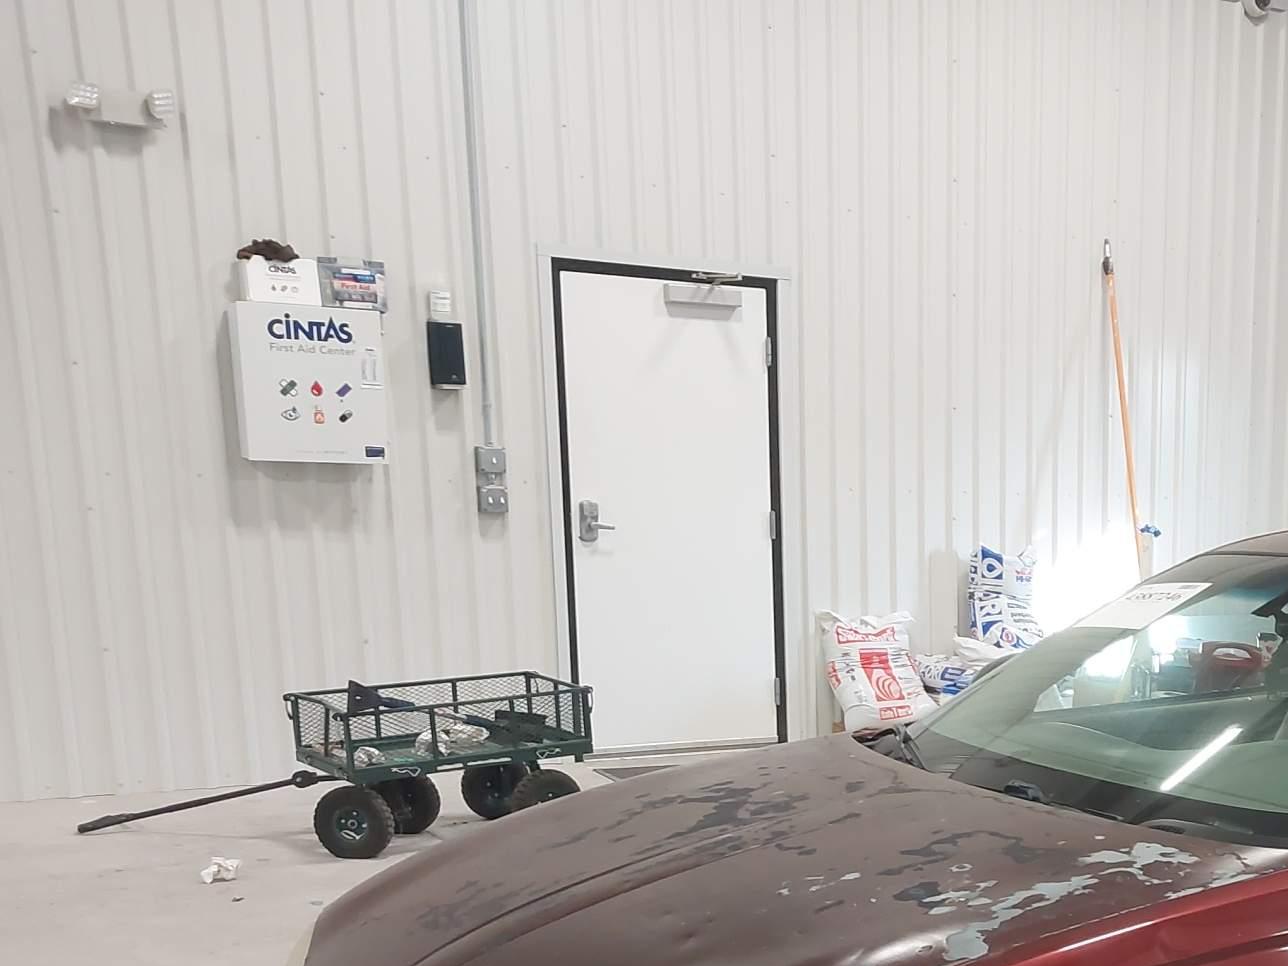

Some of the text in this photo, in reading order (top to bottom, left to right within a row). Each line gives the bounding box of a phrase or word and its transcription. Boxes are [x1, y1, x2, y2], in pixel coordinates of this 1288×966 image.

[267, 312, 353, 343] CINTAS
[269, 343, 356, 355] First Aid Center
